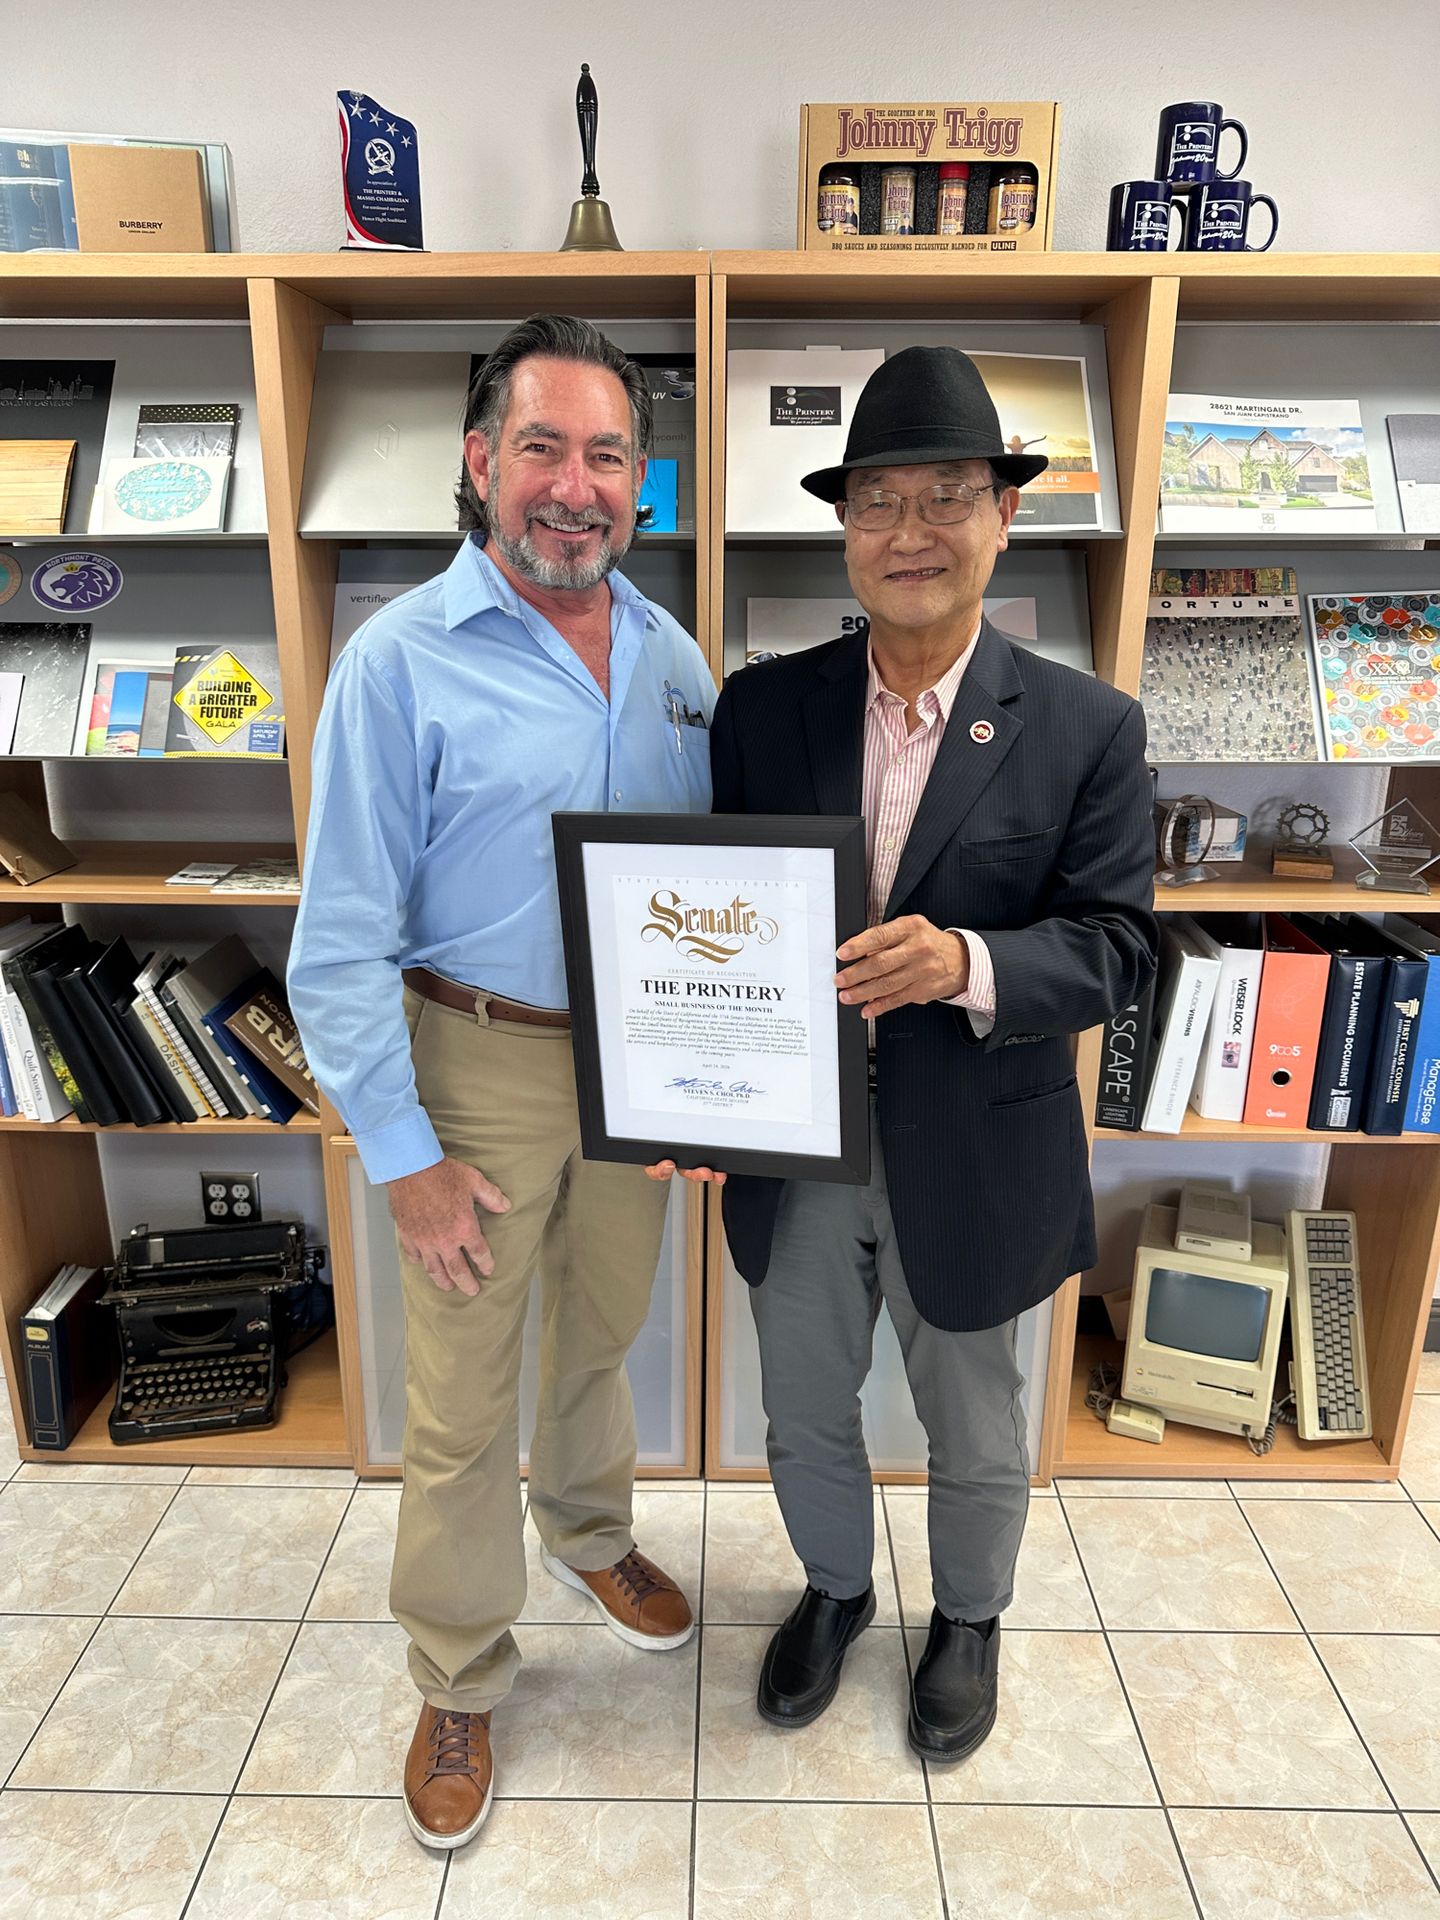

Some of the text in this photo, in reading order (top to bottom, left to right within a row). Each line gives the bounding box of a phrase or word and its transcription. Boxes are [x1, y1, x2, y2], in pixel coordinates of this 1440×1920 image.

[837, 107, 1023, 157] Johnny Trigg
[1195, 154, 1205, 162] 20
[819, 191, 848, 205] ohnny
[119, 220, 163, 229] BURBERRY
[1221, 230, 1233, 239] 20
[992, 242, 1016, 250] ULINE
[652, 391, 666, 400] UV
[776, 407, 835, 416] THE PRINTERY
[1210, 403, 1233, 411] 28621
[1236, 405, 1286, 413] MARTINGALE
[46, 554, 114, 570] NORTHMONT PRIDE
[1161, 599, 1294, 609] ORTUNE
[197, 681, 252, 693] BUILDING
[188, 694, 257, 706] A BRIGHTER
[200, 706, 244, 719] FUTURE
[641, 889, 779, 952] Senate
[641, 980, 786, 1002] THE PRINTERY
[681, 1002, 715, 1010] BUSINESS
[745, 1006, 773, 1014] MONTH
[1232, 977, 1248, 1035] WEISER LOCK
[1339, 962, 1364, 1087] ESTATE PLANNING DOCUMENTS
[1269, 1044, 1302, 1056] 9to5
[160, 1044, 183, 1076] DASH
[1391, 1019, 1412, 1104] FIRST CLASS COUNSEL
[24, 1050, 38, 1072] Quilt
[31, 1072, 42, 1101] Stories
